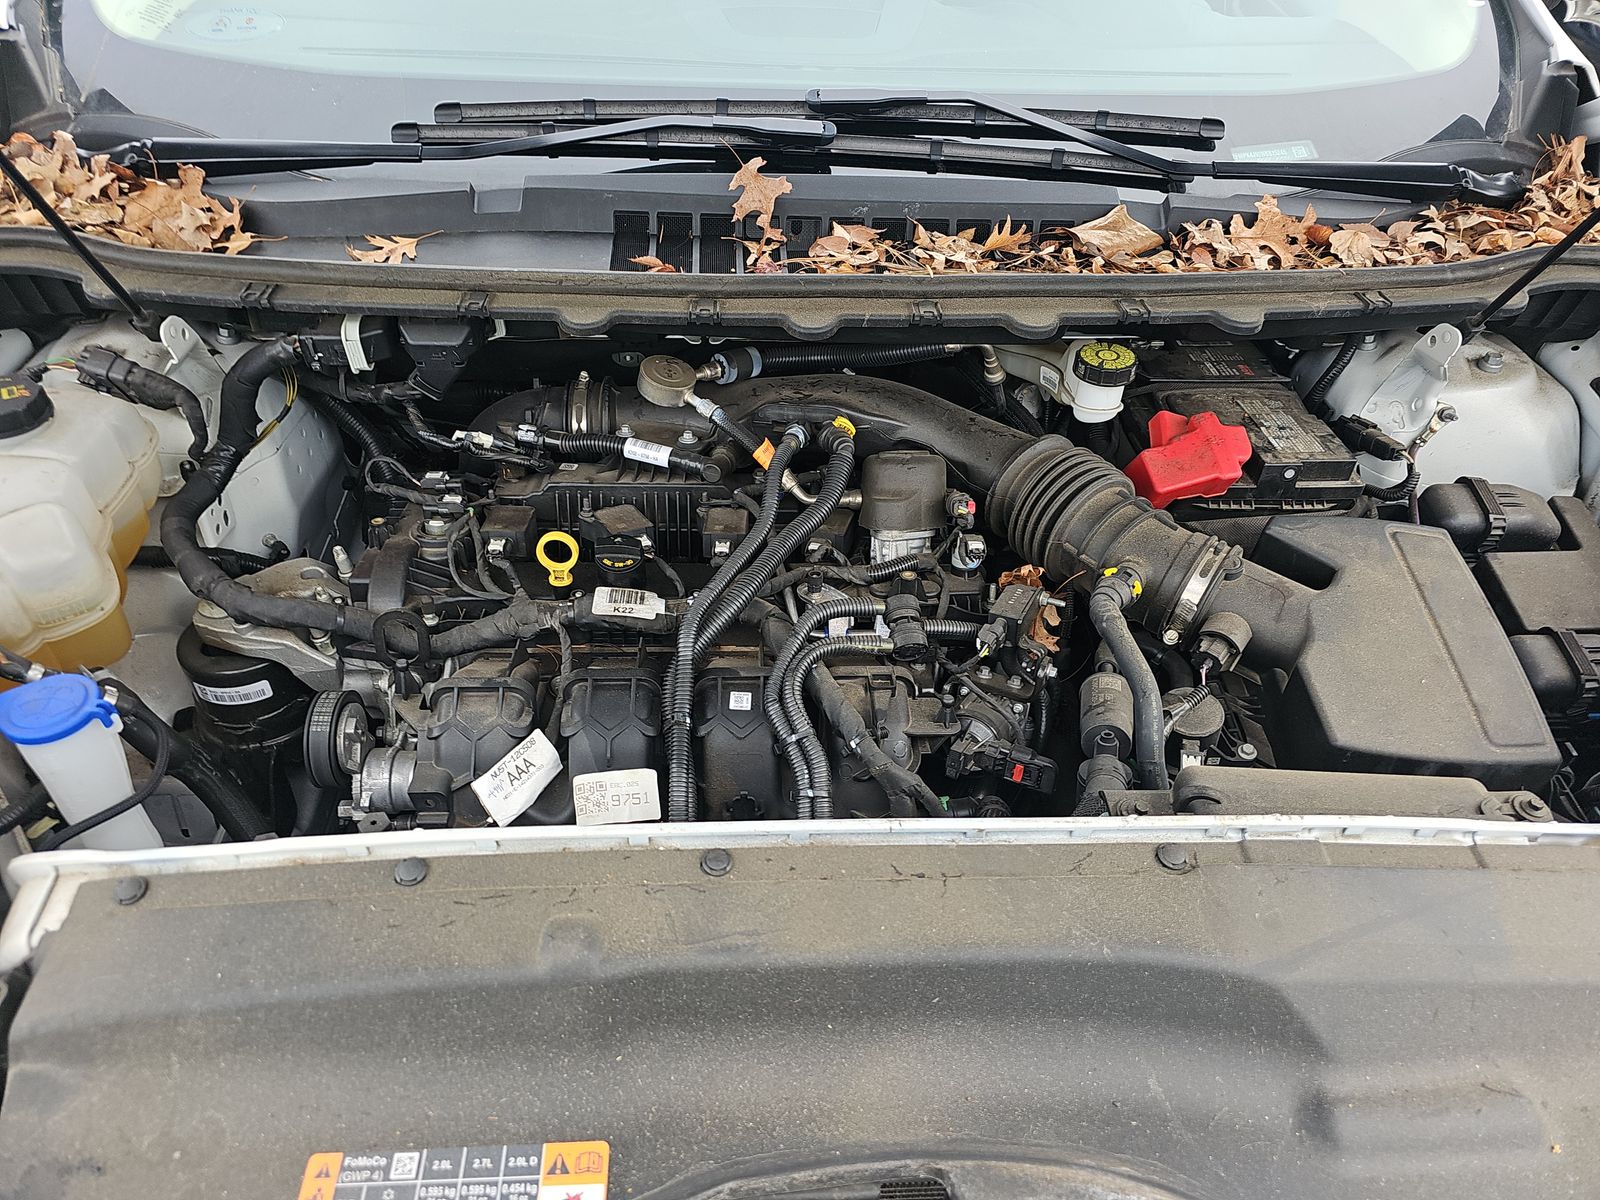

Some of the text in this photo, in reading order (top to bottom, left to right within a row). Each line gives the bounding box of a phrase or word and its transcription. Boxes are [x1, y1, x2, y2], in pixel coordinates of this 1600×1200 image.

[612, 606, 635, 614] K22
[507, 757, 537, 788] AAA
[611, 791, 650, 807] 9751
[344, 1155, 387, 1166] FoMoCo
[432, 1160, 452, 1170] 2.0L
[472, 1158, 493, 1168] 2.7L
[338, 1169, 384, 1183] (GWP 4)
[444, 1185, 456, 1199] kg
[485, 1184, 497, 1197] kg
[526, 1182, 538, 1195] kg
